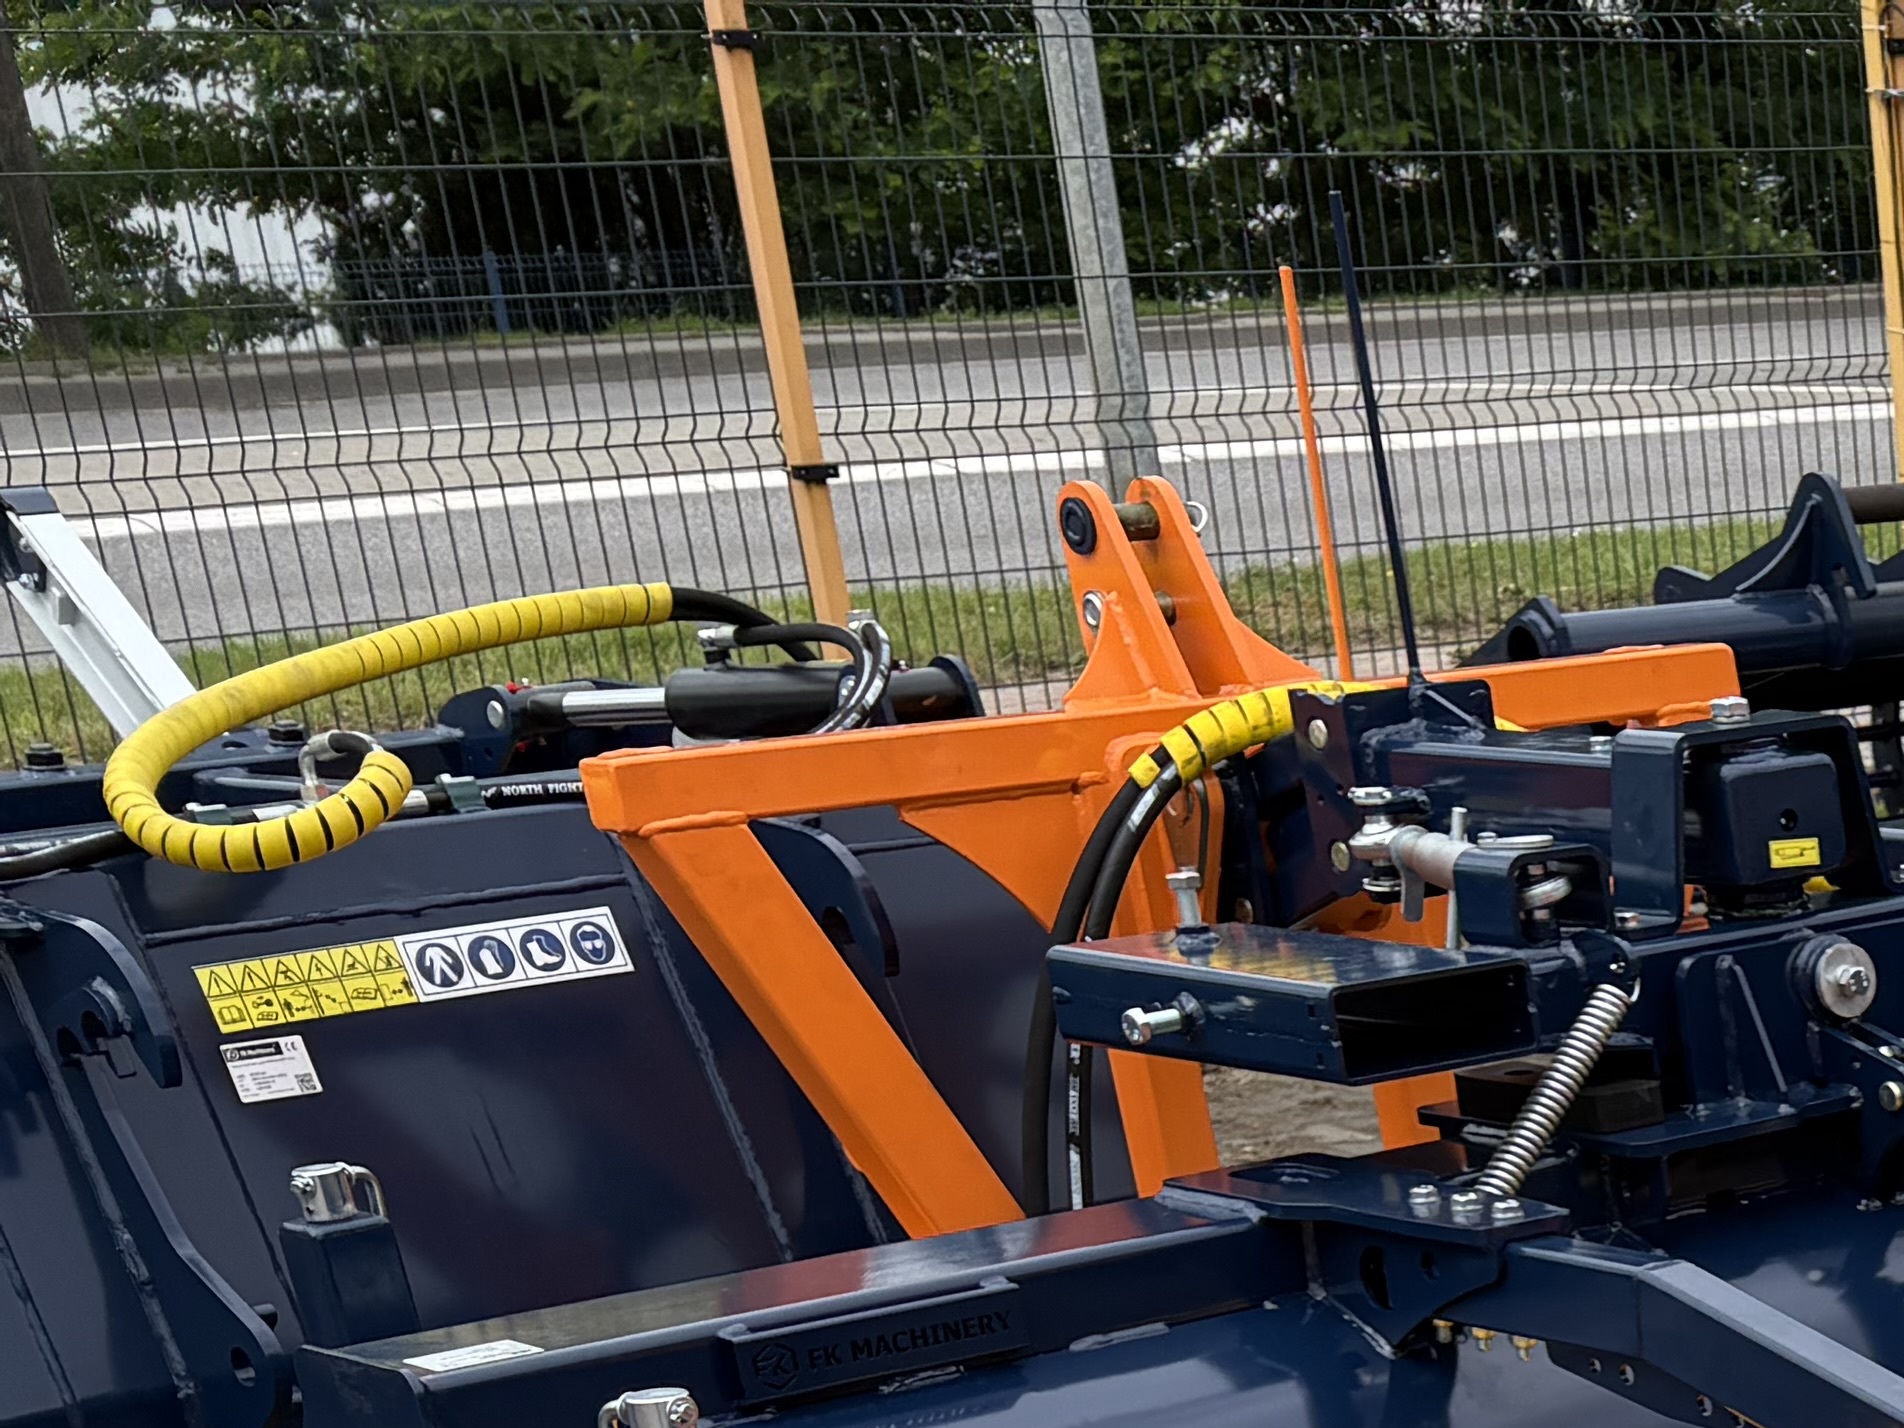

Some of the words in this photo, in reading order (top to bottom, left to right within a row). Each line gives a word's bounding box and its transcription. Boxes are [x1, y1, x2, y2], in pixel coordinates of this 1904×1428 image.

[501, 783, 544, 797] NORTH
[806, 1344, 844, 1371] FK
[851, 1310, 1011, 1362] MACHINERY
